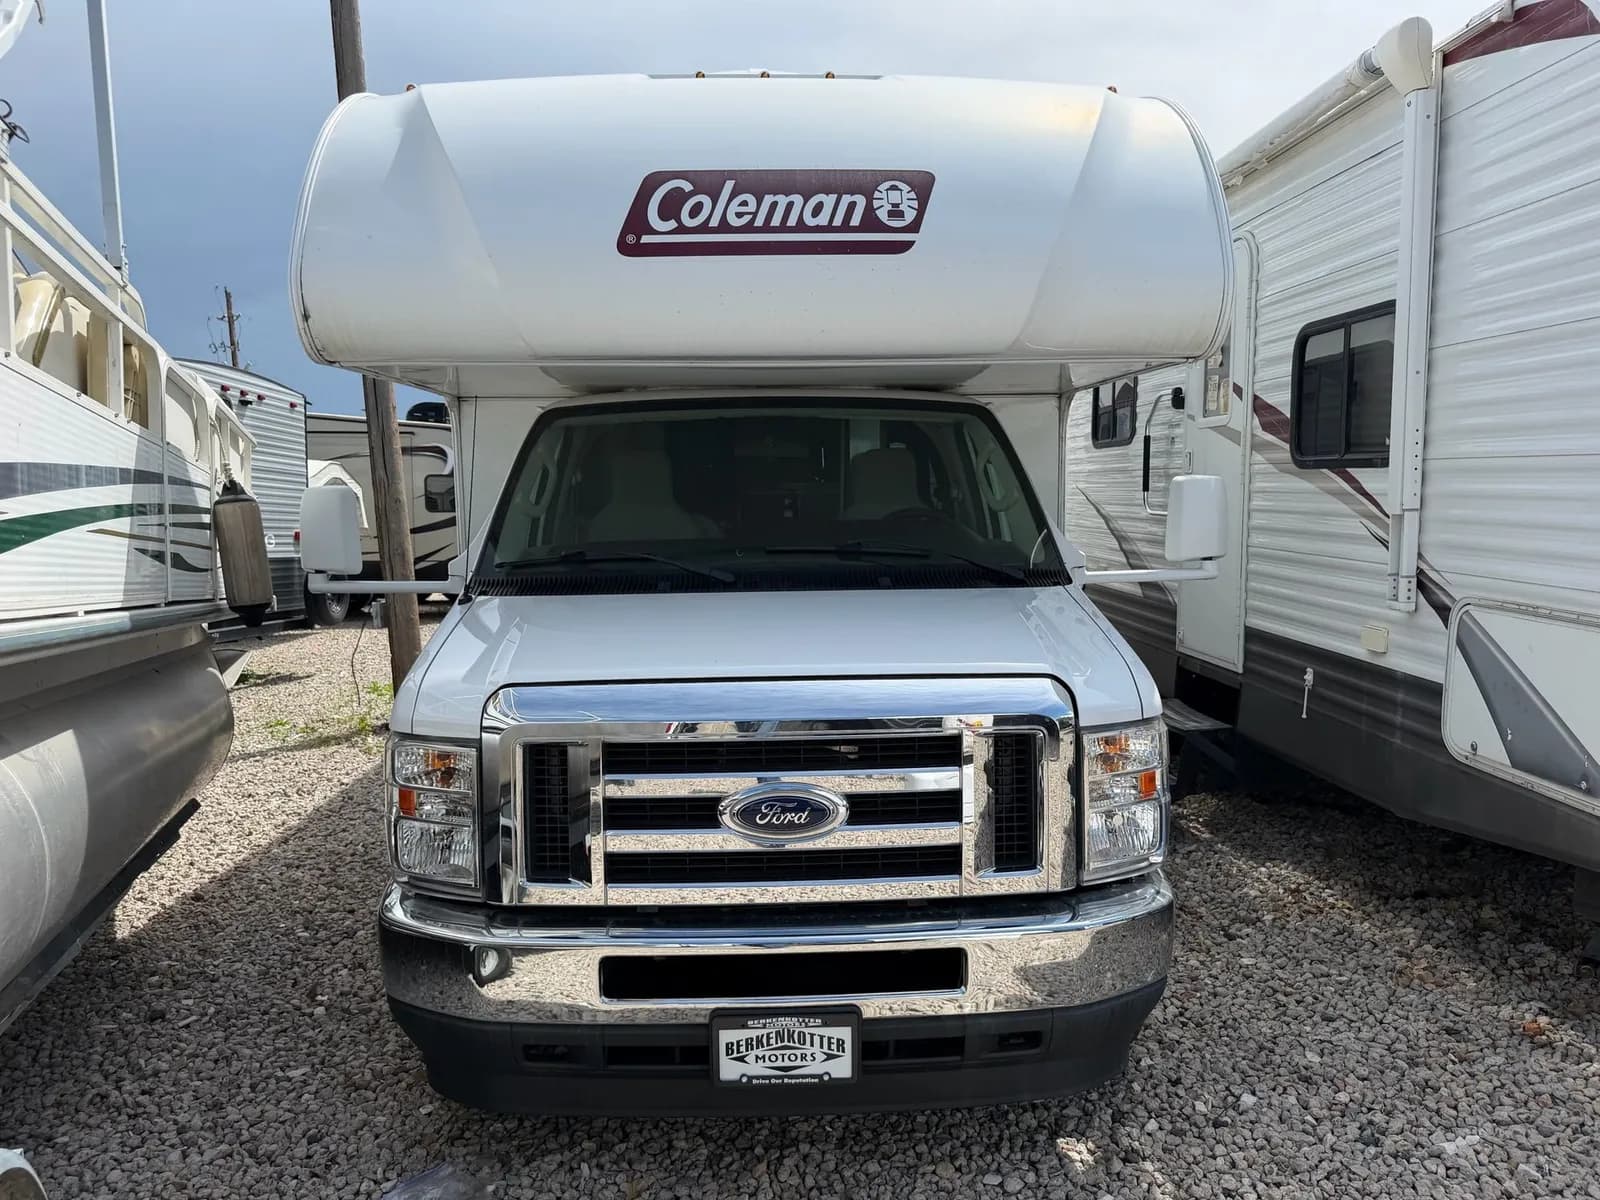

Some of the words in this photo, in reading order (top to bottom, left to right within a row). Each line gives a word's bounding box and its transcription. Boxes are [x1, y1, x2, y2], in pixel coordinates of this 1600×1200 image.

[647, 178, 867, 232] Coleman
[755, 801, 811, 825] Ford
[747, 1016, 822, 1025] BERKENKOTTER
[725, 1027, 846, 1057] BERKENKOTTER
[755, 1052, 817, 1064] MOTORS
[783, 1076, 819, 1085] Reputation
